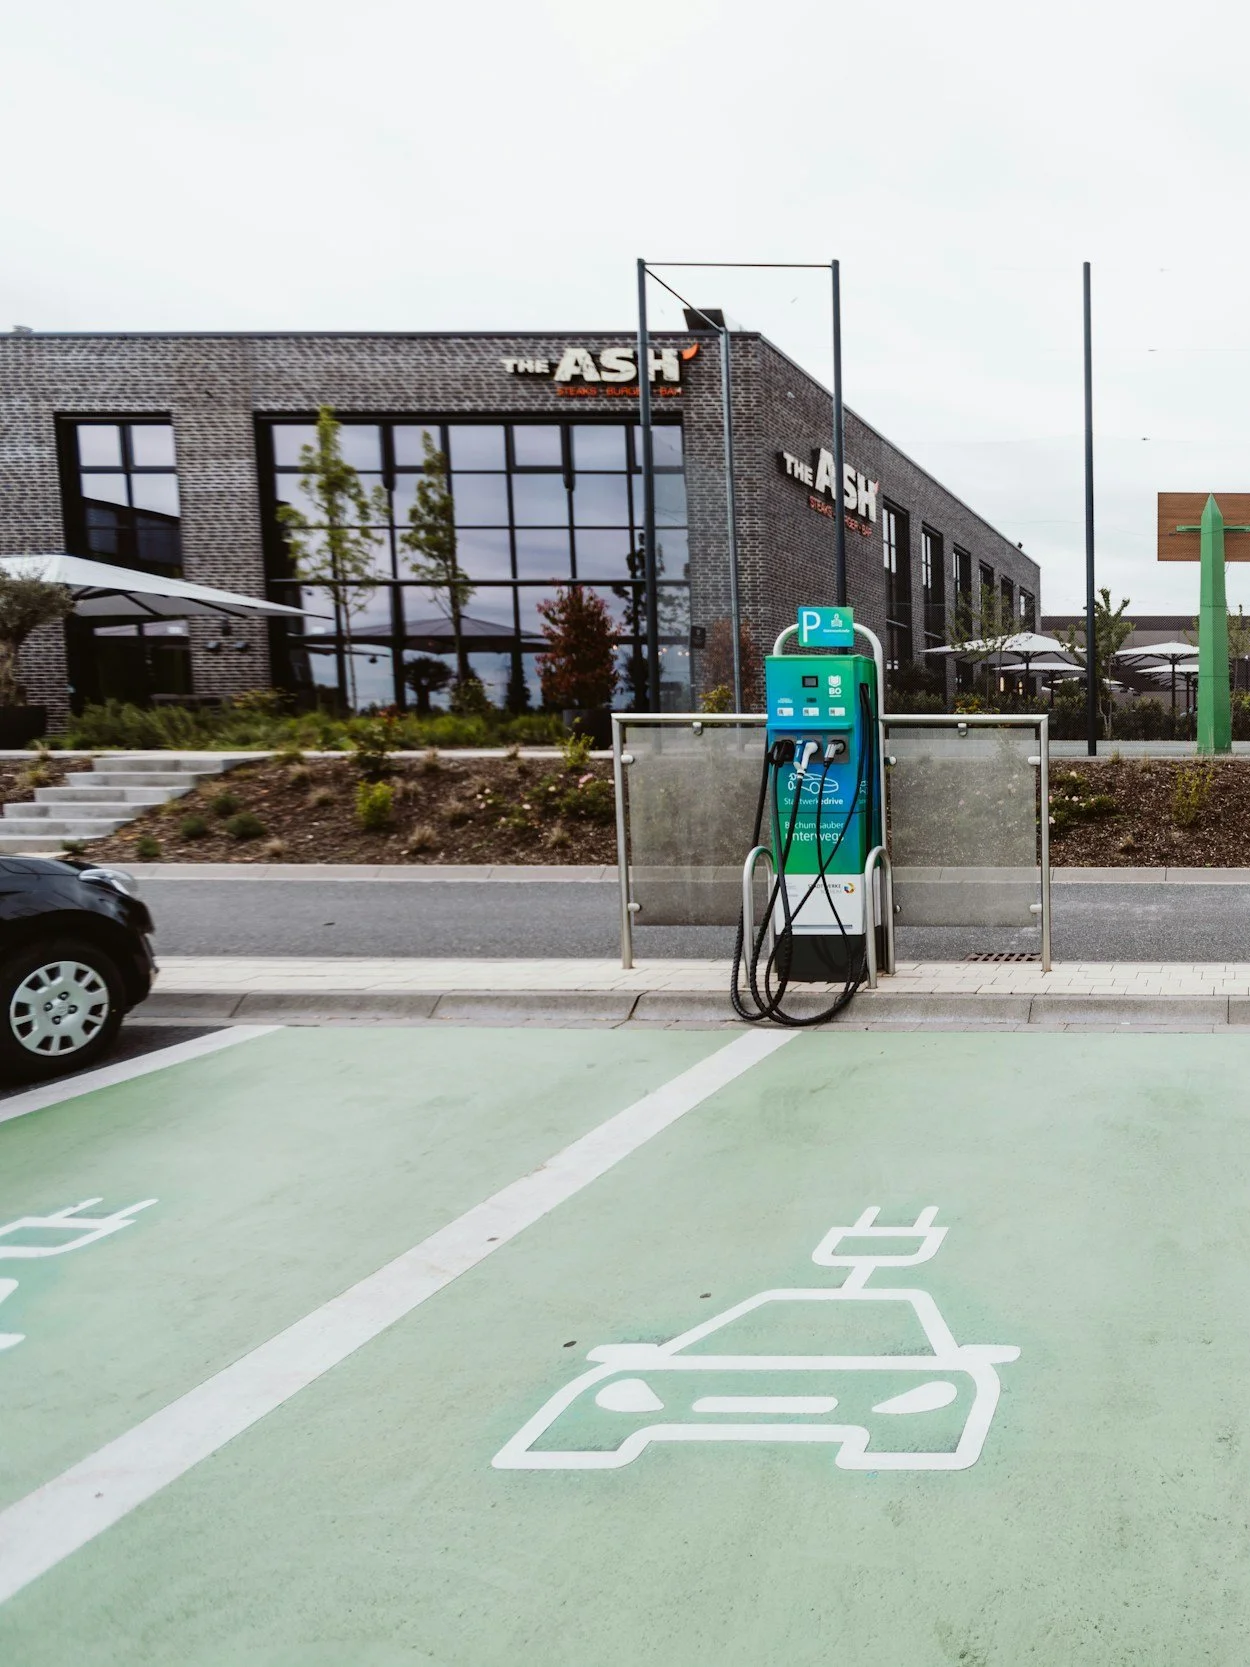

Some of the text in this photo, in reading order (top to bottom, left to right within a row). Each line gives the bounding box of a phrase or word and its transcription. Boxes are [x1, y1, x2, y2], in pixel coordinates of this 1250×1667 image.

[501, 347, 681, 383] THE ASH
[556, 386, 598, 397] STEAKS
[783, 447, 879, 523] THE ASH
[803, 611, 821, 643] P
[828, 687, 842, 695] BO
[784, 821, 816, 829] Bchum
